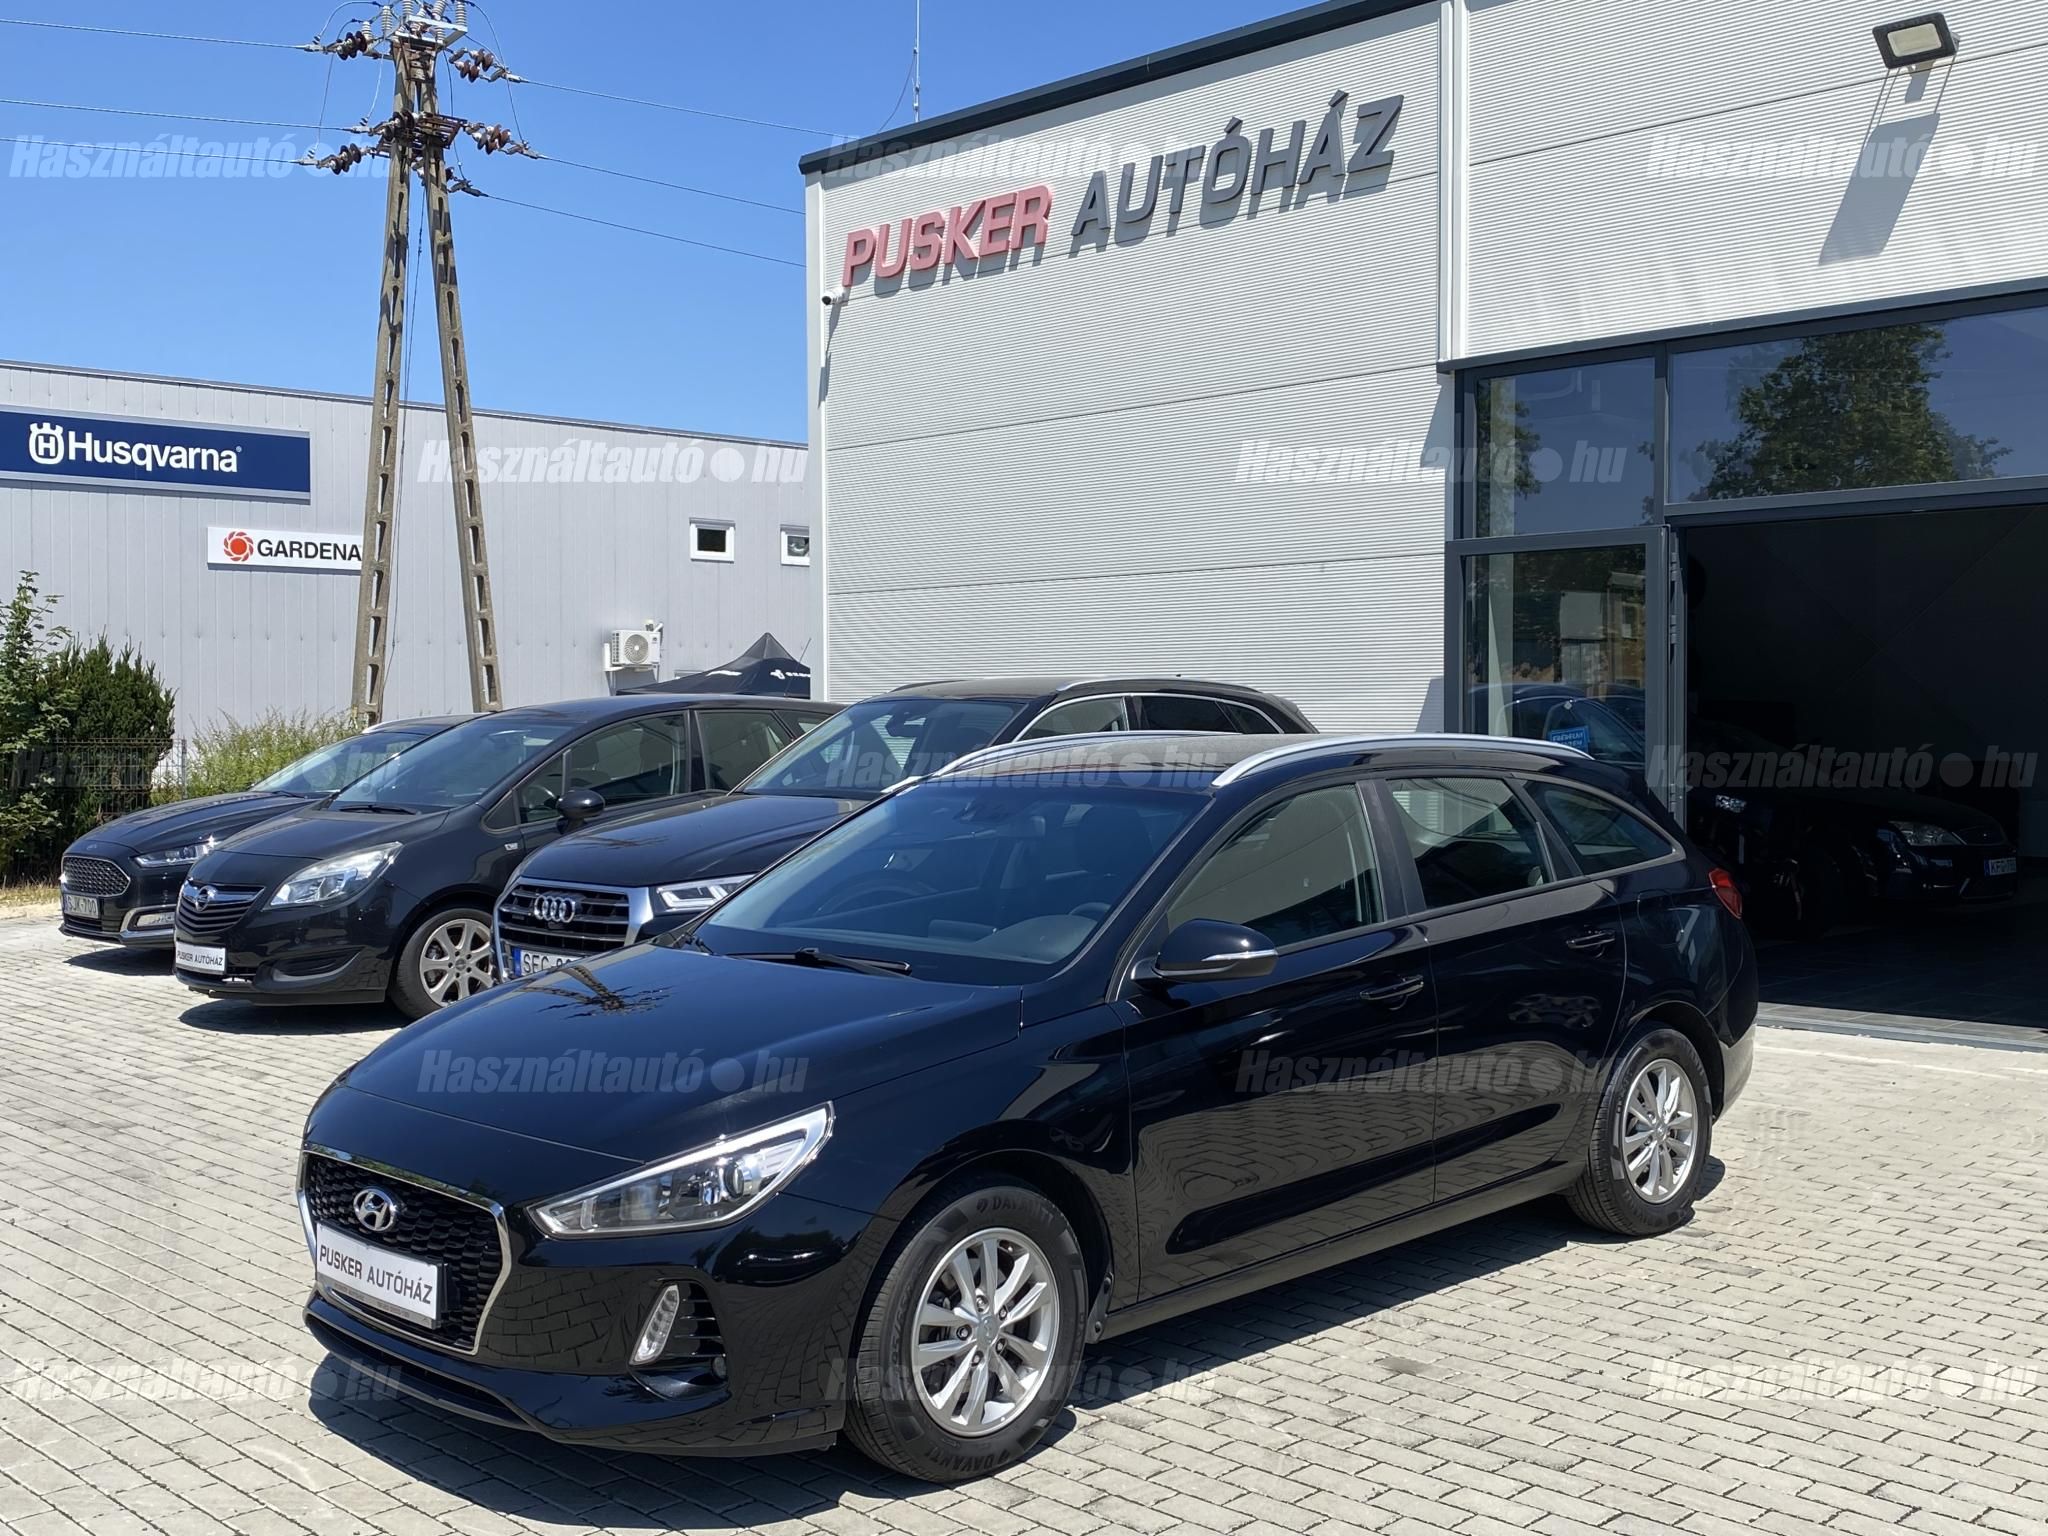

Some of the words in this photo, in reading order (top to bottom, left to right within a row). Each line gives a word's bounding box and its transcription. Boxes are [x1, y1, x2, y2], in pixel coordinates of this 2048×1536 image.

[842, 184, 1053, 286] PUSKER
[1072, 89, 1404, 237] AUTÓHÁZ
[68, 430, 238, 473] Husqvarna
[257, 539, 362, 562] GARDENA
[319, 1245, 363, 1280] PUSKER
[367, 1266, 433, 1305] AUTÓHÁZ
